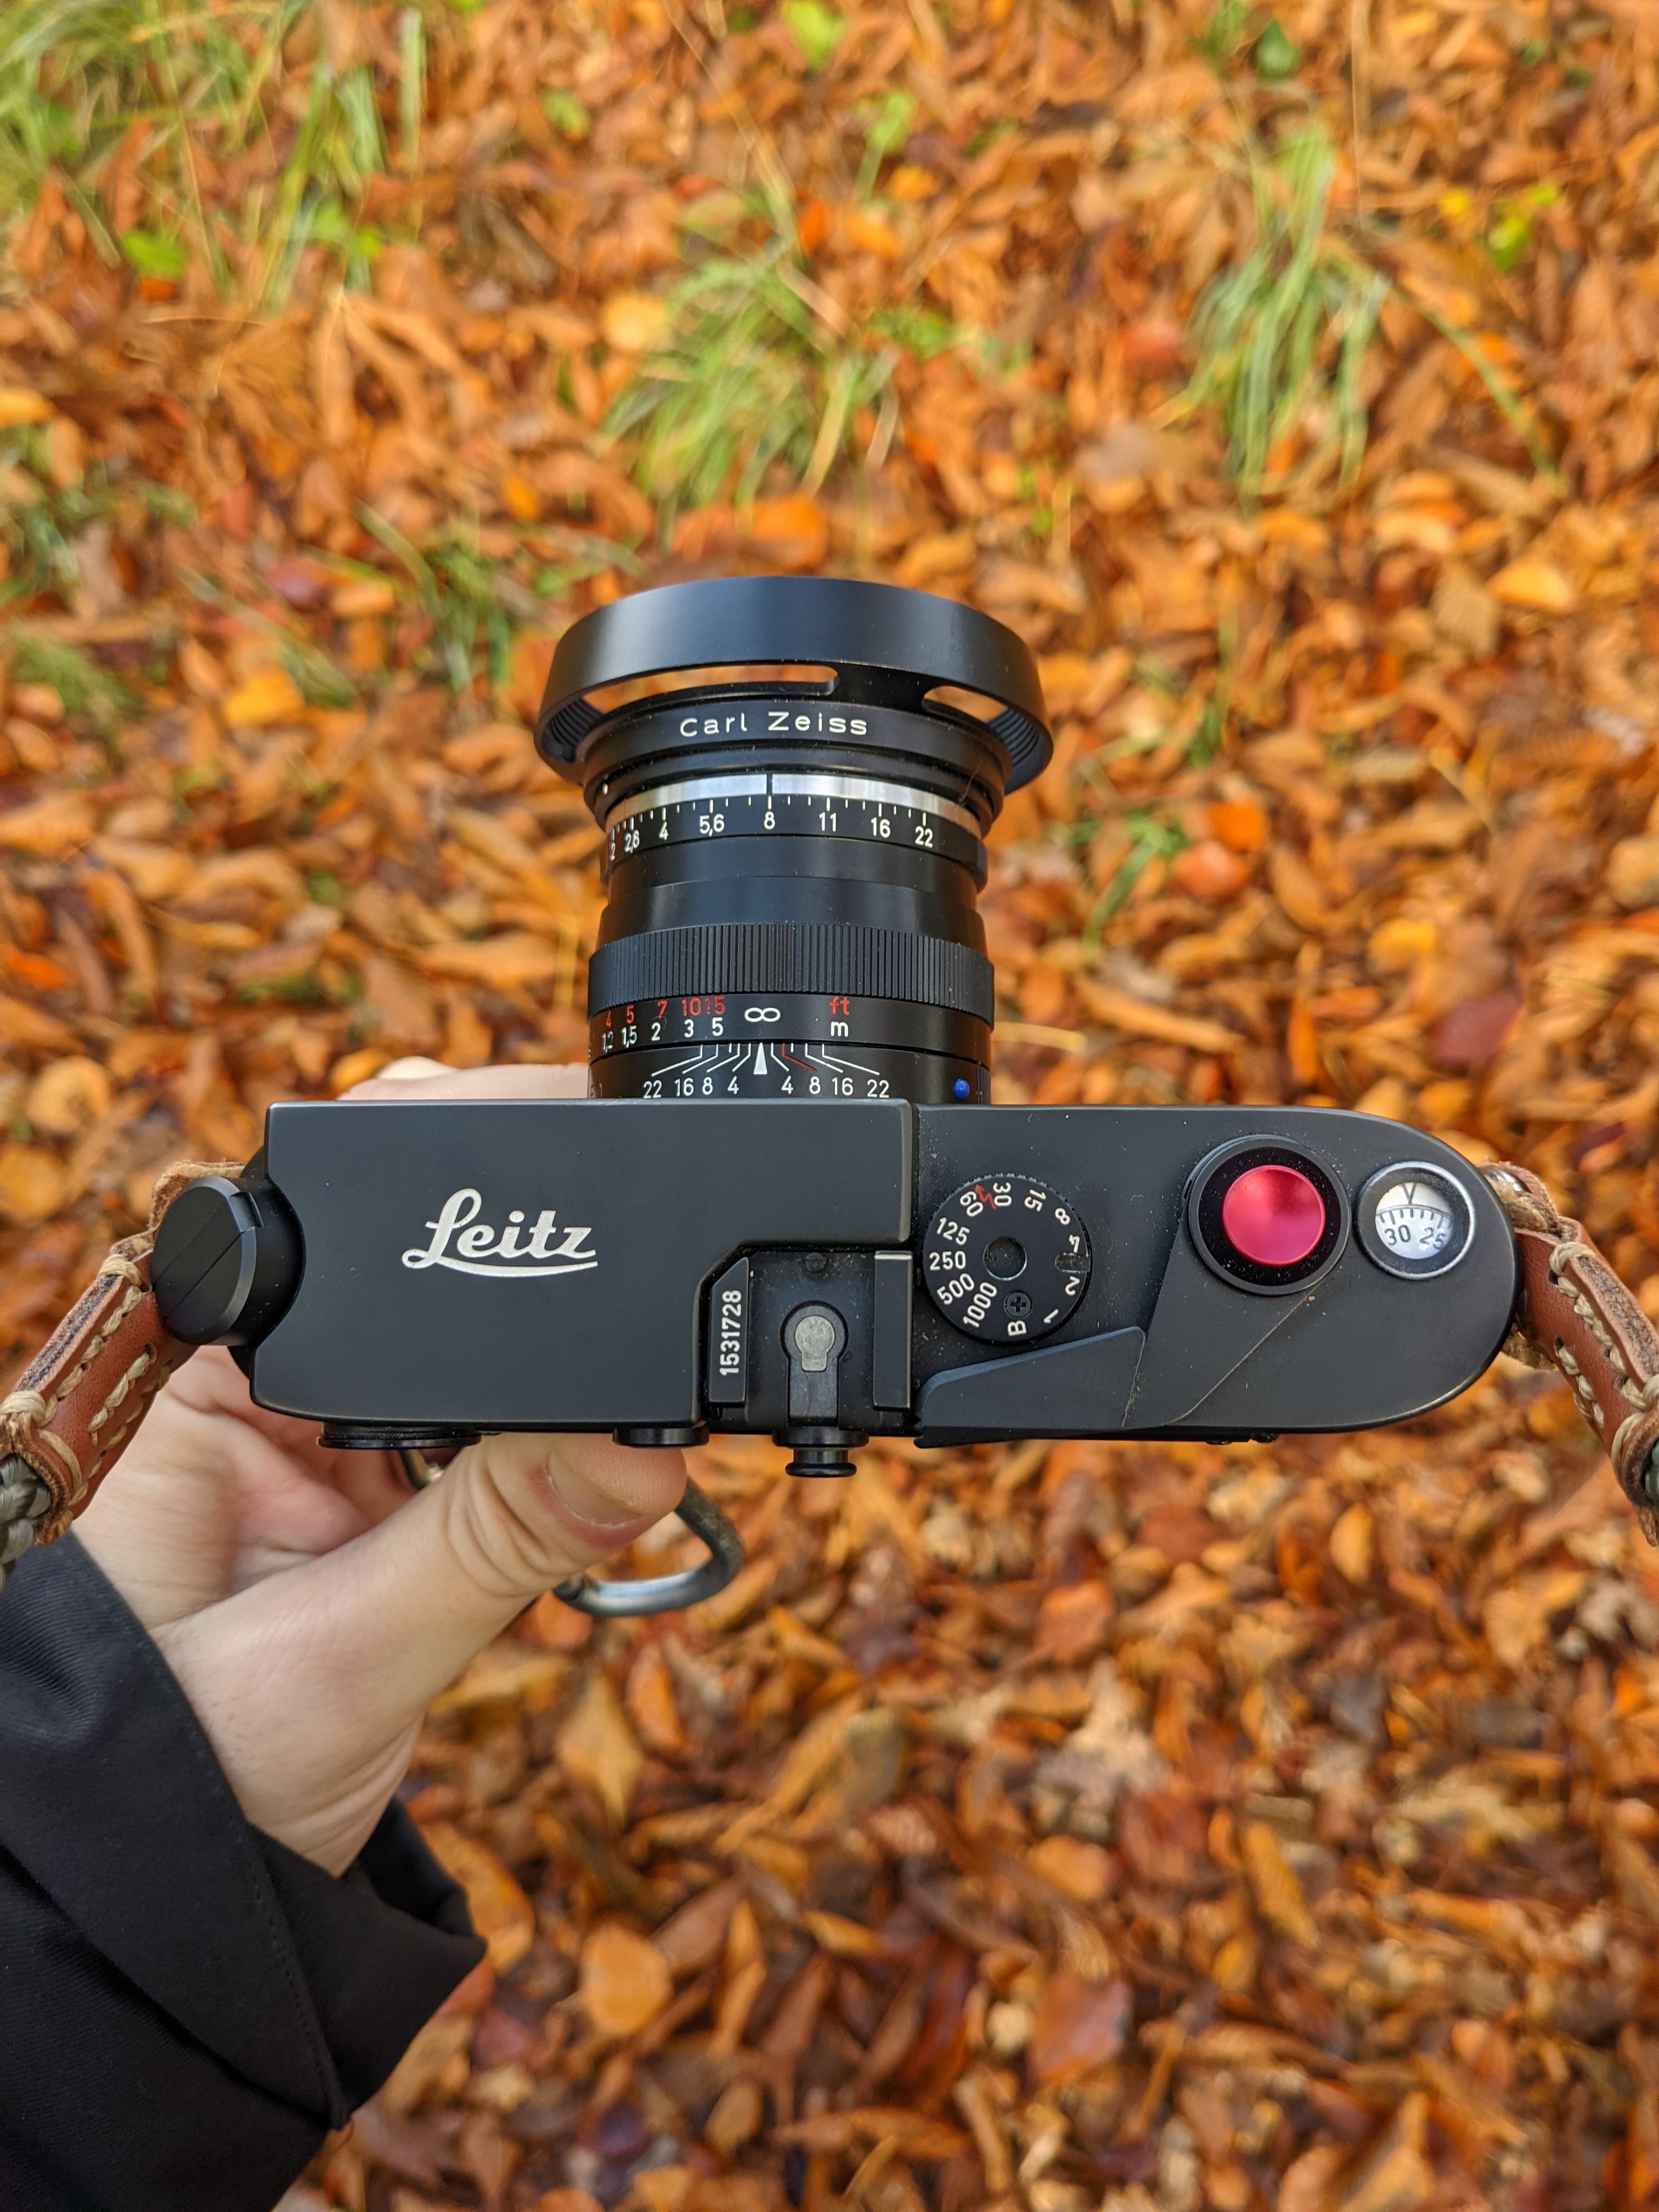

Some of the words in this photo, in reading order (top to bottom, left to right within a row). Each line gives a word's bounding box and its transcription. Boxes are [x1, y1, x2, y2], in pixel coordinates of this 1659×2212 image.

[680, 713, 748, 737] Carl
[768, 712, 867, 735] Zeiss
[609, 842, 616, 861] 2
[659, 821, 669, 840] 4
[764, 811, 776, 830] 8
[818, 812, 837, 832] 11
[871, 817, 891, 838] 16
[915, 826, 933, 848] 22
[605, 1011, 612, 1028] 4
[627, 1005, 635, 1024] 5
[658, 999, 668, 1019] 7
[681, 996, 702, 1016] 10
[704, 995, 726, 1015] 15
[828, 996, 850, 1016] ft
[651, 1022, 661, 1041] 2
[684, 1019, 694, 1038] 3
[712, 1017, 724, 1036] 5
[831, 1021, 849, 1037] m
[643, 1080, 662, 1099] 22
[675, 1077, 694, 1097] 16
[702, 1076, 713, 1095] 8
[727, 1076, 740, 1094] 4
[781, 1076, 794, 1094] 4
[809, 1076, 821, 1094] 8
[832, 1077, 854, 1096] 16
[867, 1079, 889, 1098] 22
[960, 1191, 983, 1217] 60
[993, 1182, 1012, 1206] 30
[1024, 1189, 1046, 1211] 15
[1054, 1208, 1070, 1225] 8
[402, 1188, 598, 1277] Leitz
[936, 1217, 970, 1245] 125
[1069, 1234, 1080, 1252] 4
[1384, 1224, 1410, 1245] 30
[1419, 1227, 1446, 1250] 25
[929, 1251, 966, 1271] 250
[936, 1273, 975, 1305] 500
[1065, 1276, 1080, 1295] 2
[963, 1282, 997, 1328] 1000
[1043, 1308, 1059, 1323] 1
[719, 1290, 742, 1376] 1531728
[1007, 1320, 1027, 1336] B
